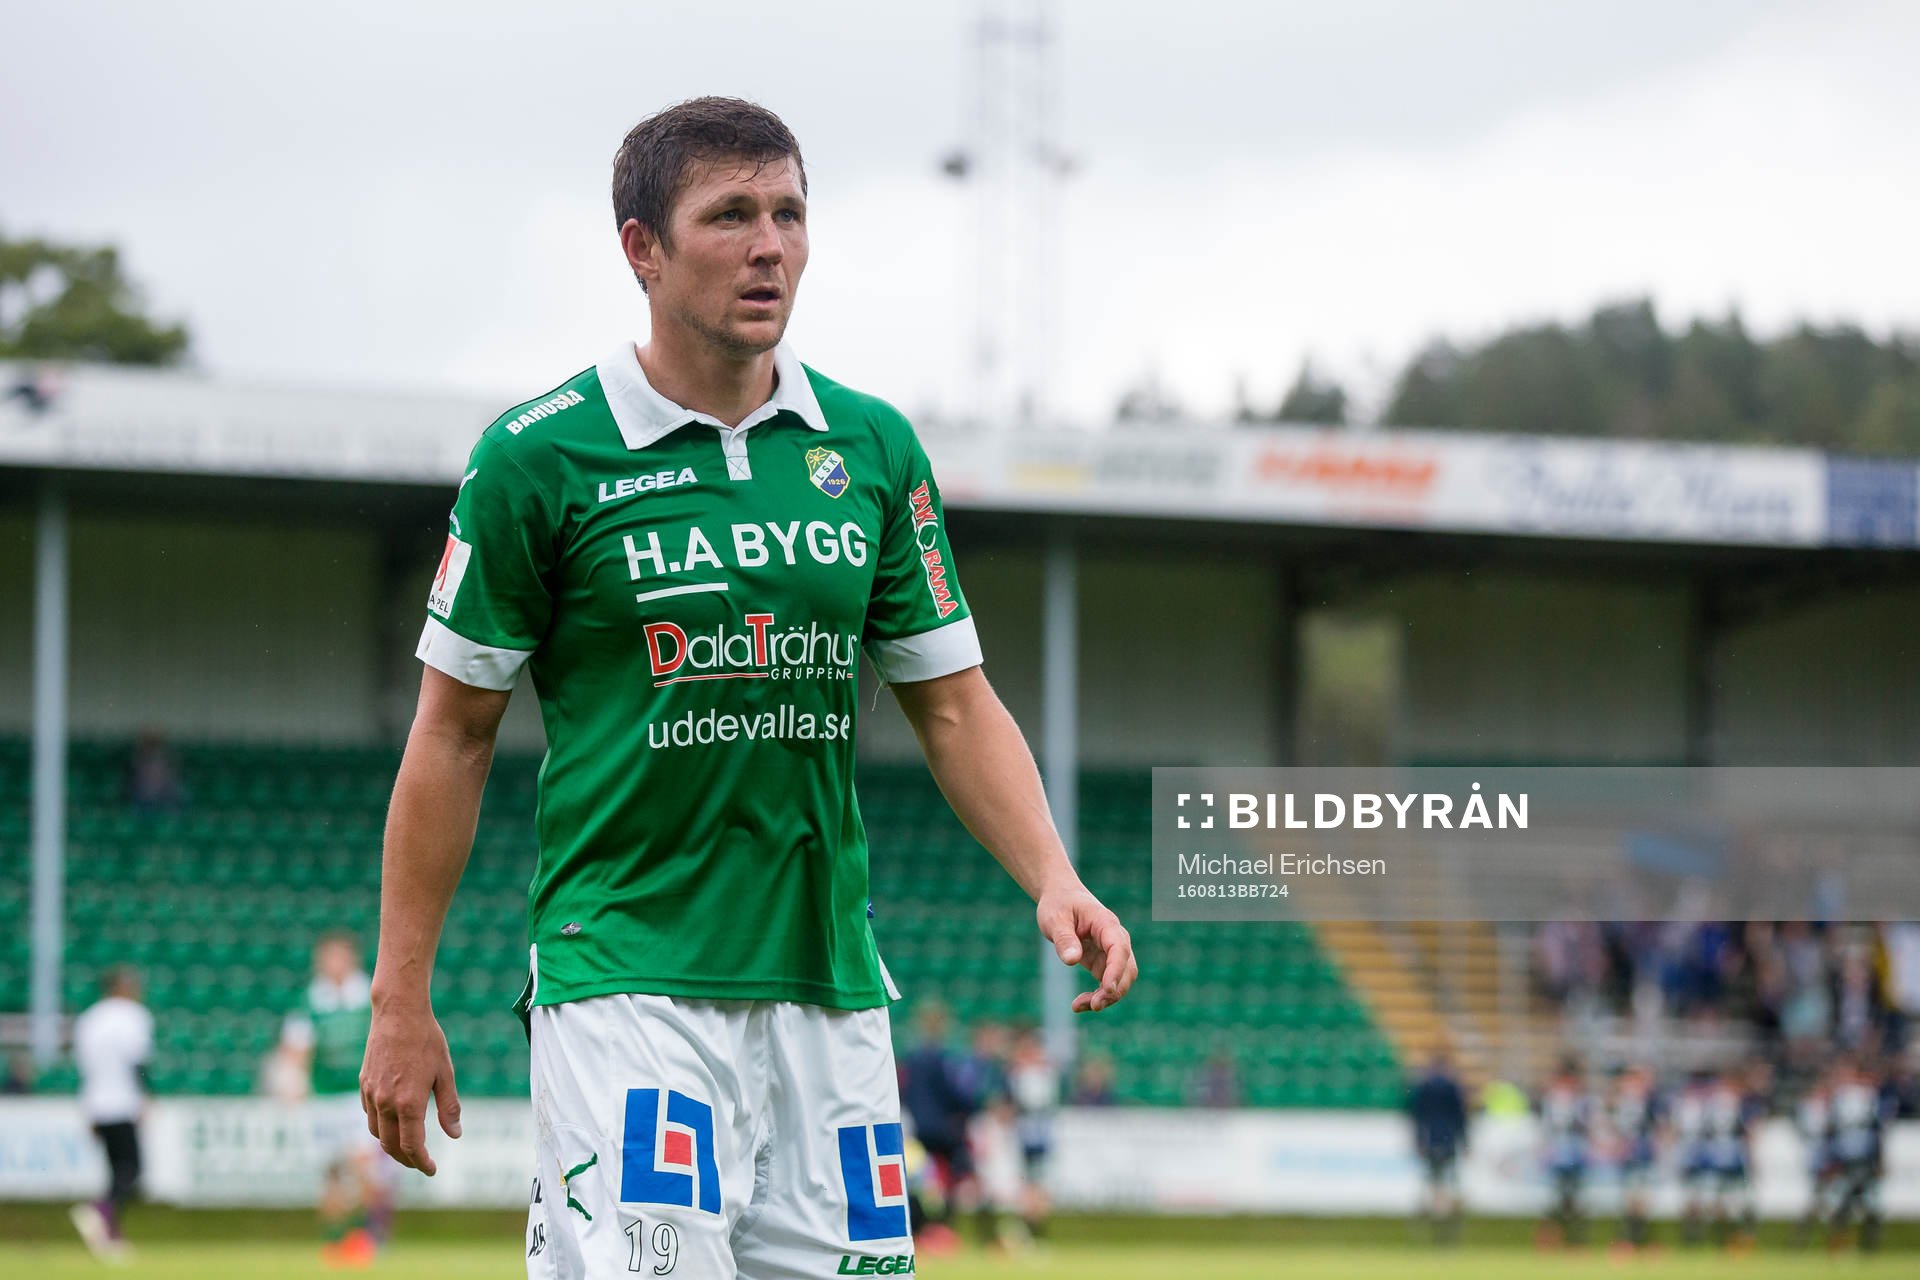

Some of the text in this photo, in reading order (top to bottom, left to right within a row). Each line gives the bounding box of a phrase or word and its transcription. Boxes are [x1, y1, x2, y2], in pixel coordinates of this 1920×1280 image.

[598, 467, 699, 503] LEGEA
[622, 520, 867, 581] H.A BYGG
[770, 667, 847, 680] GRUPPEN
[648, 704, 850, 749] uddevalla.se
[624, 1219, 679, 1276] 19
